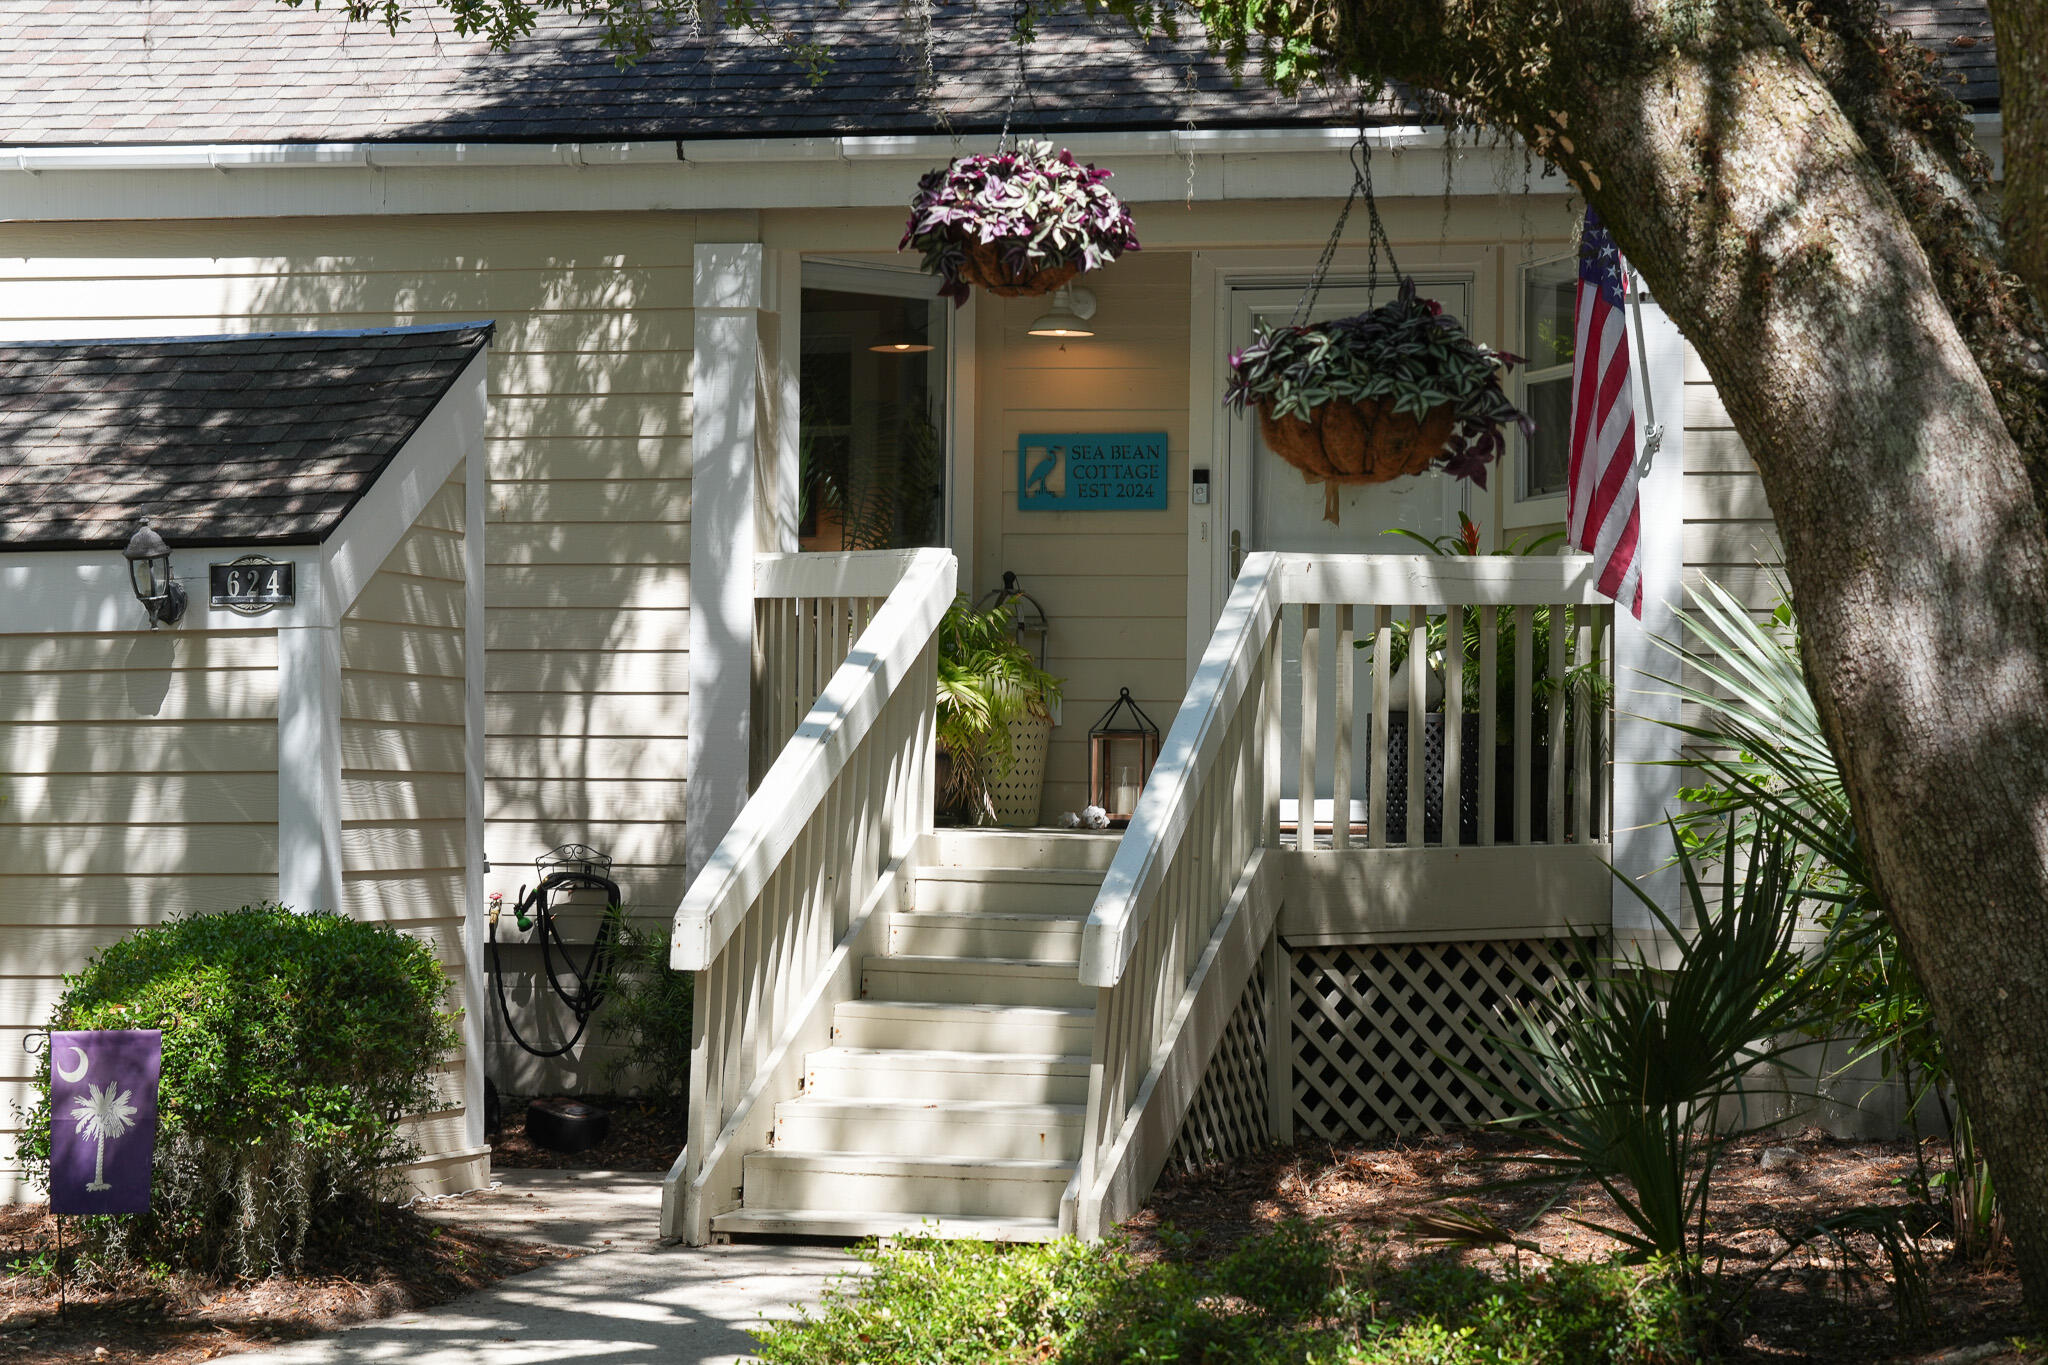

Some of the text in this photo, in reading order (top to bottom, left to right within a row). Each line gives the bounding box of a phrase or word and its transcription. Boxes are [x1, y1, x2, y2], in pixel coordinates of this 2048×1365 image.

[1072, 444, 1160, 460] SEA BEAN
[1073, 464, 1160, 480] COTTAGE
[1078, 483, 1155, 498] EST 2024
[227, 569, 279, 597] 624
